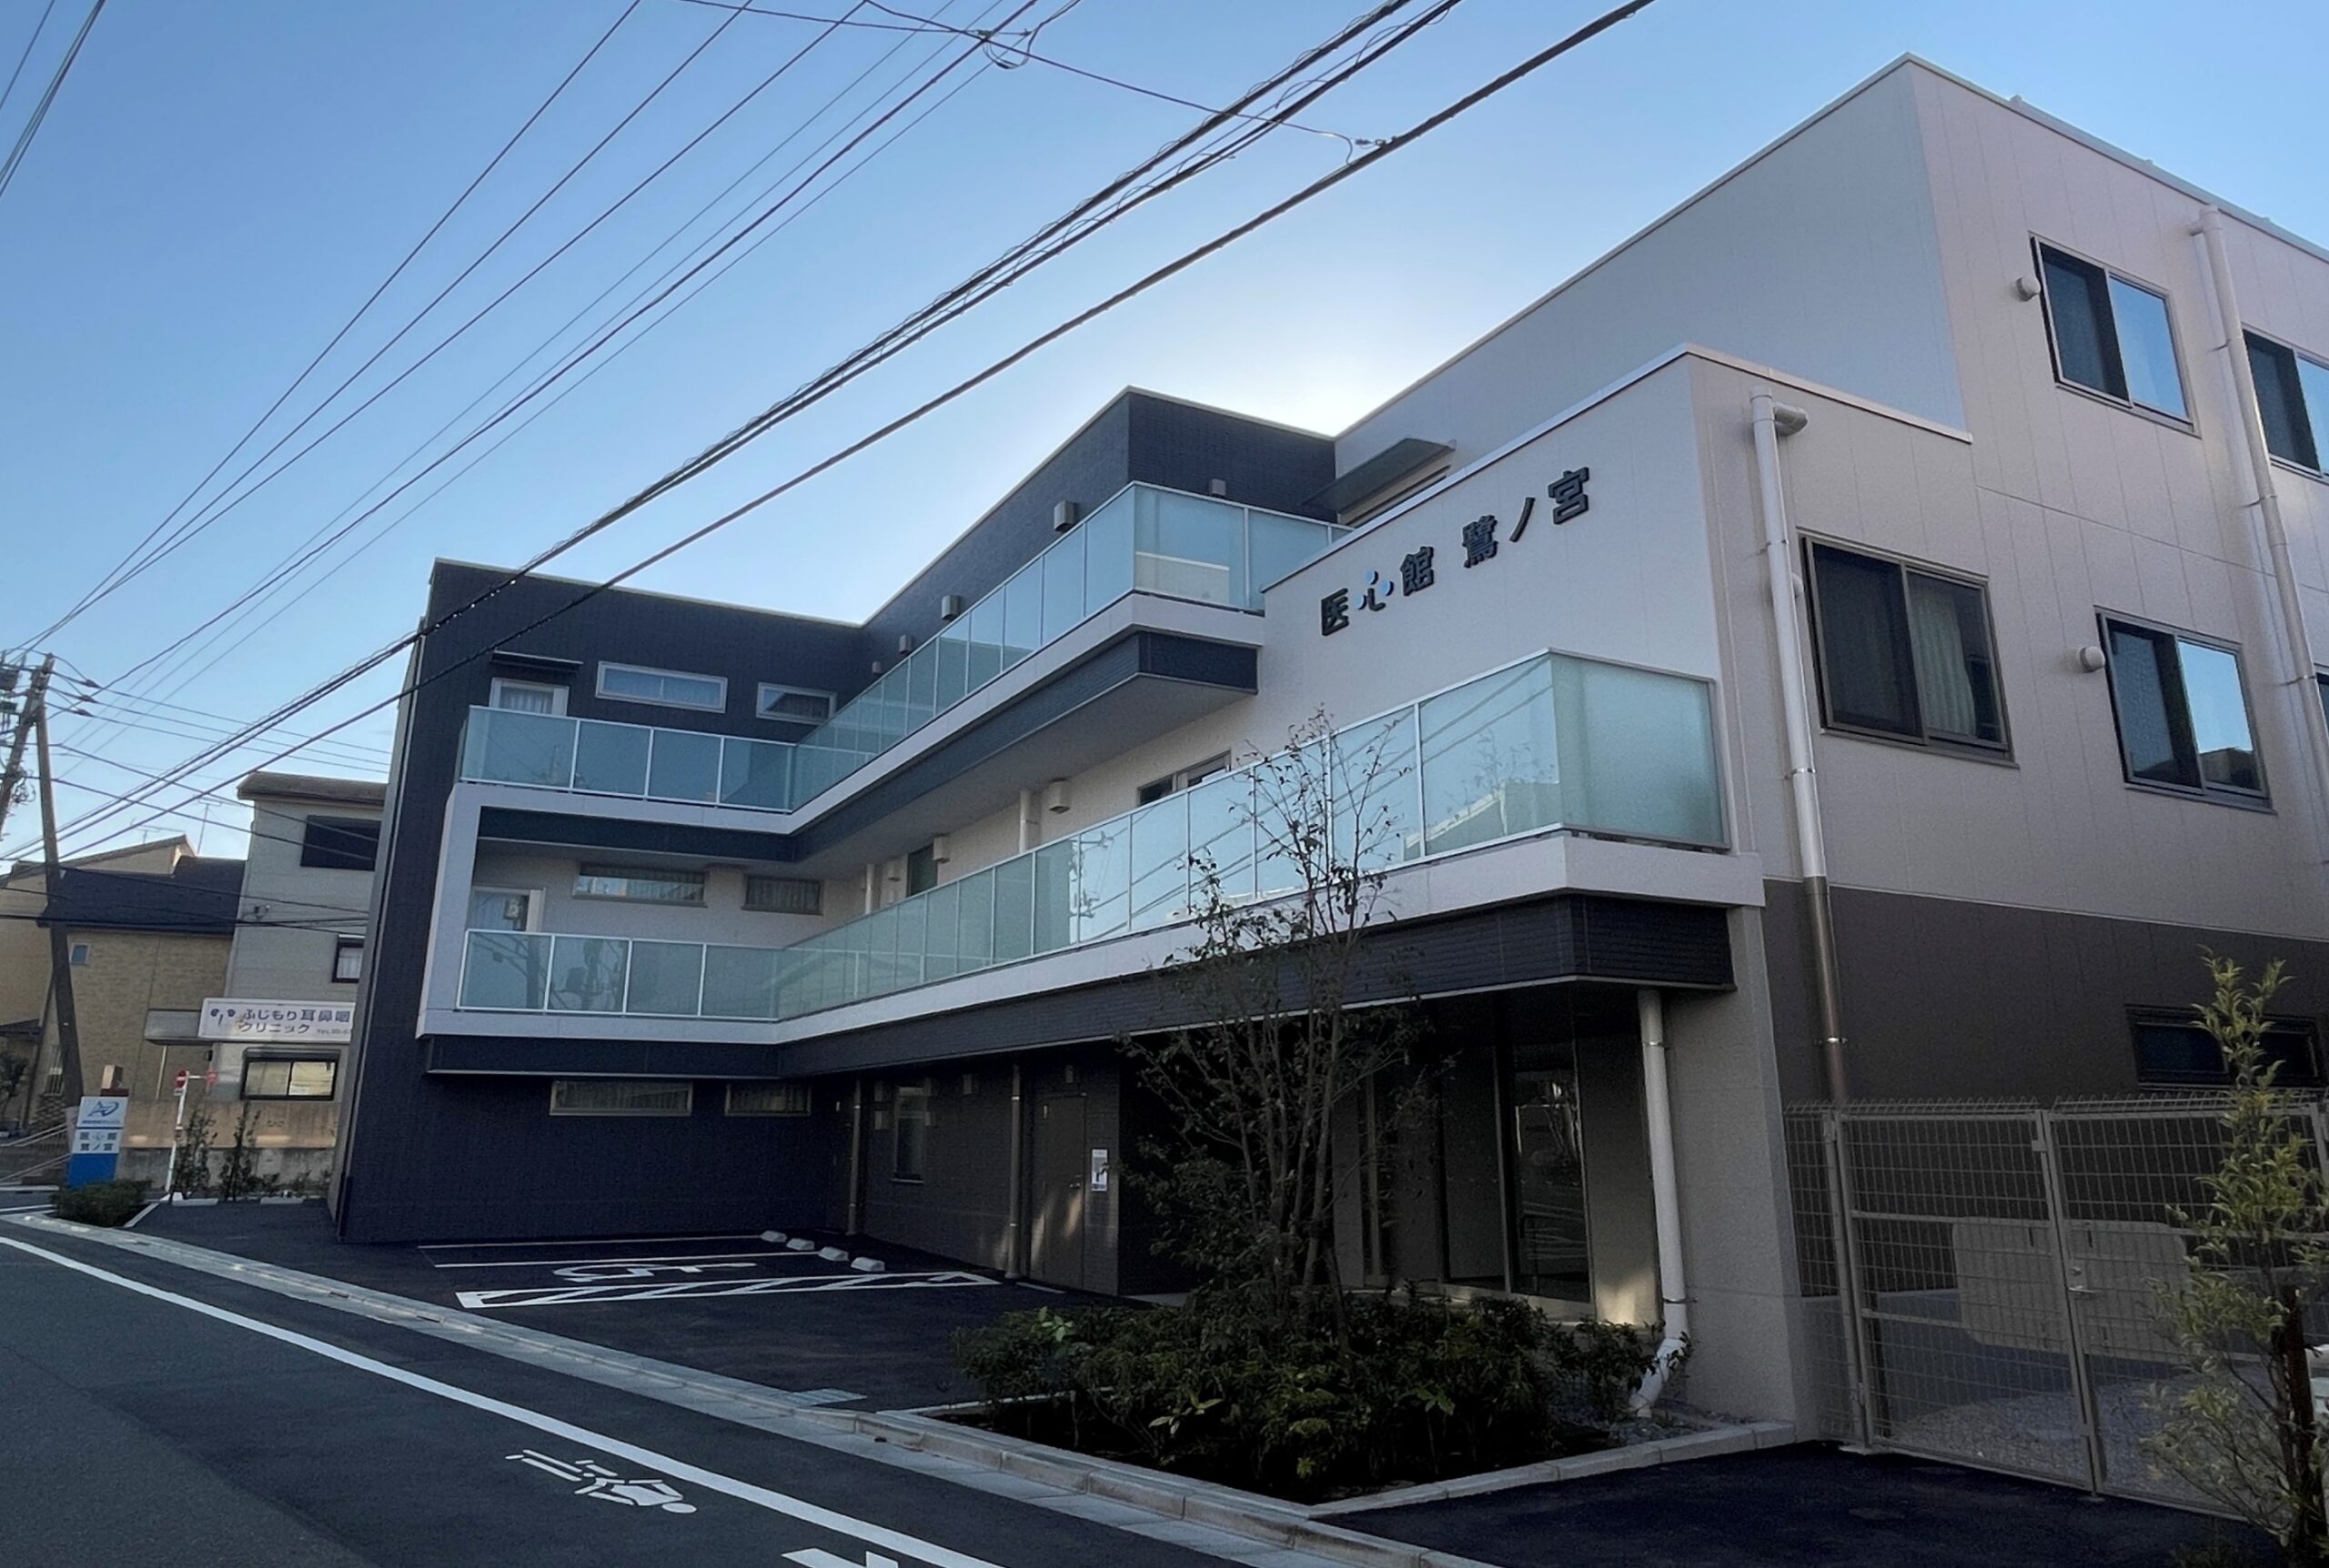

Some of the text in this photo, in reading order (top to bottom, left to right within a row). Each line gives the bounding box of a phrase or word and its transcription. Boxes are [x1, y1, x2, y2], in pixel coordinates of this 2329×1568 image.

[1320, 467, 1590, 636] 医心館 鷺ノ宮
[240, 1021, 310, 1034] クリニック
